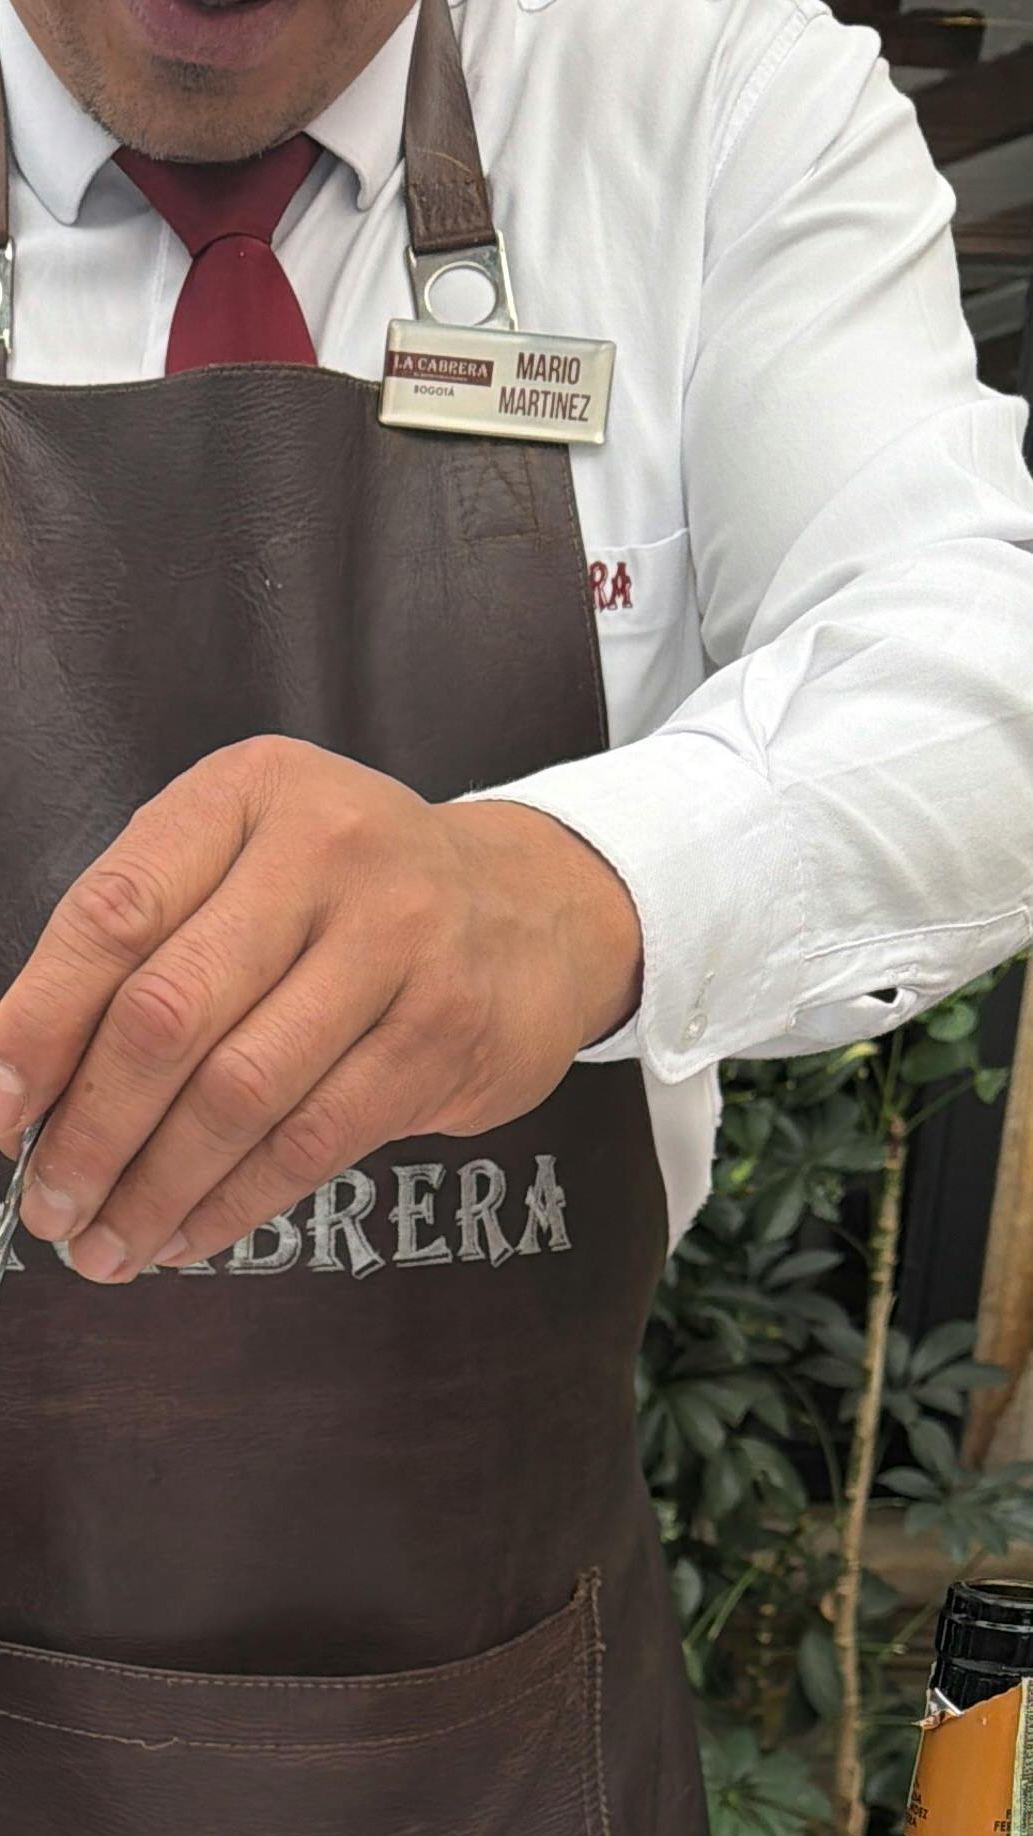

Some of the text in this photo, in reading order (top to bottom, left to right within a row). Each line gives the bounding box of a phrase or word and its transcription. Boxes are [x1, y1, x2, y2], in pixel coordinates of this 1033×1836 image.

[394, 353, 413, 370] LA
[417, 357, 488, 378] CABRERA
[516, 352, 581, 385] MARIO
[498, 386, 592, 423] MARTINEZ
